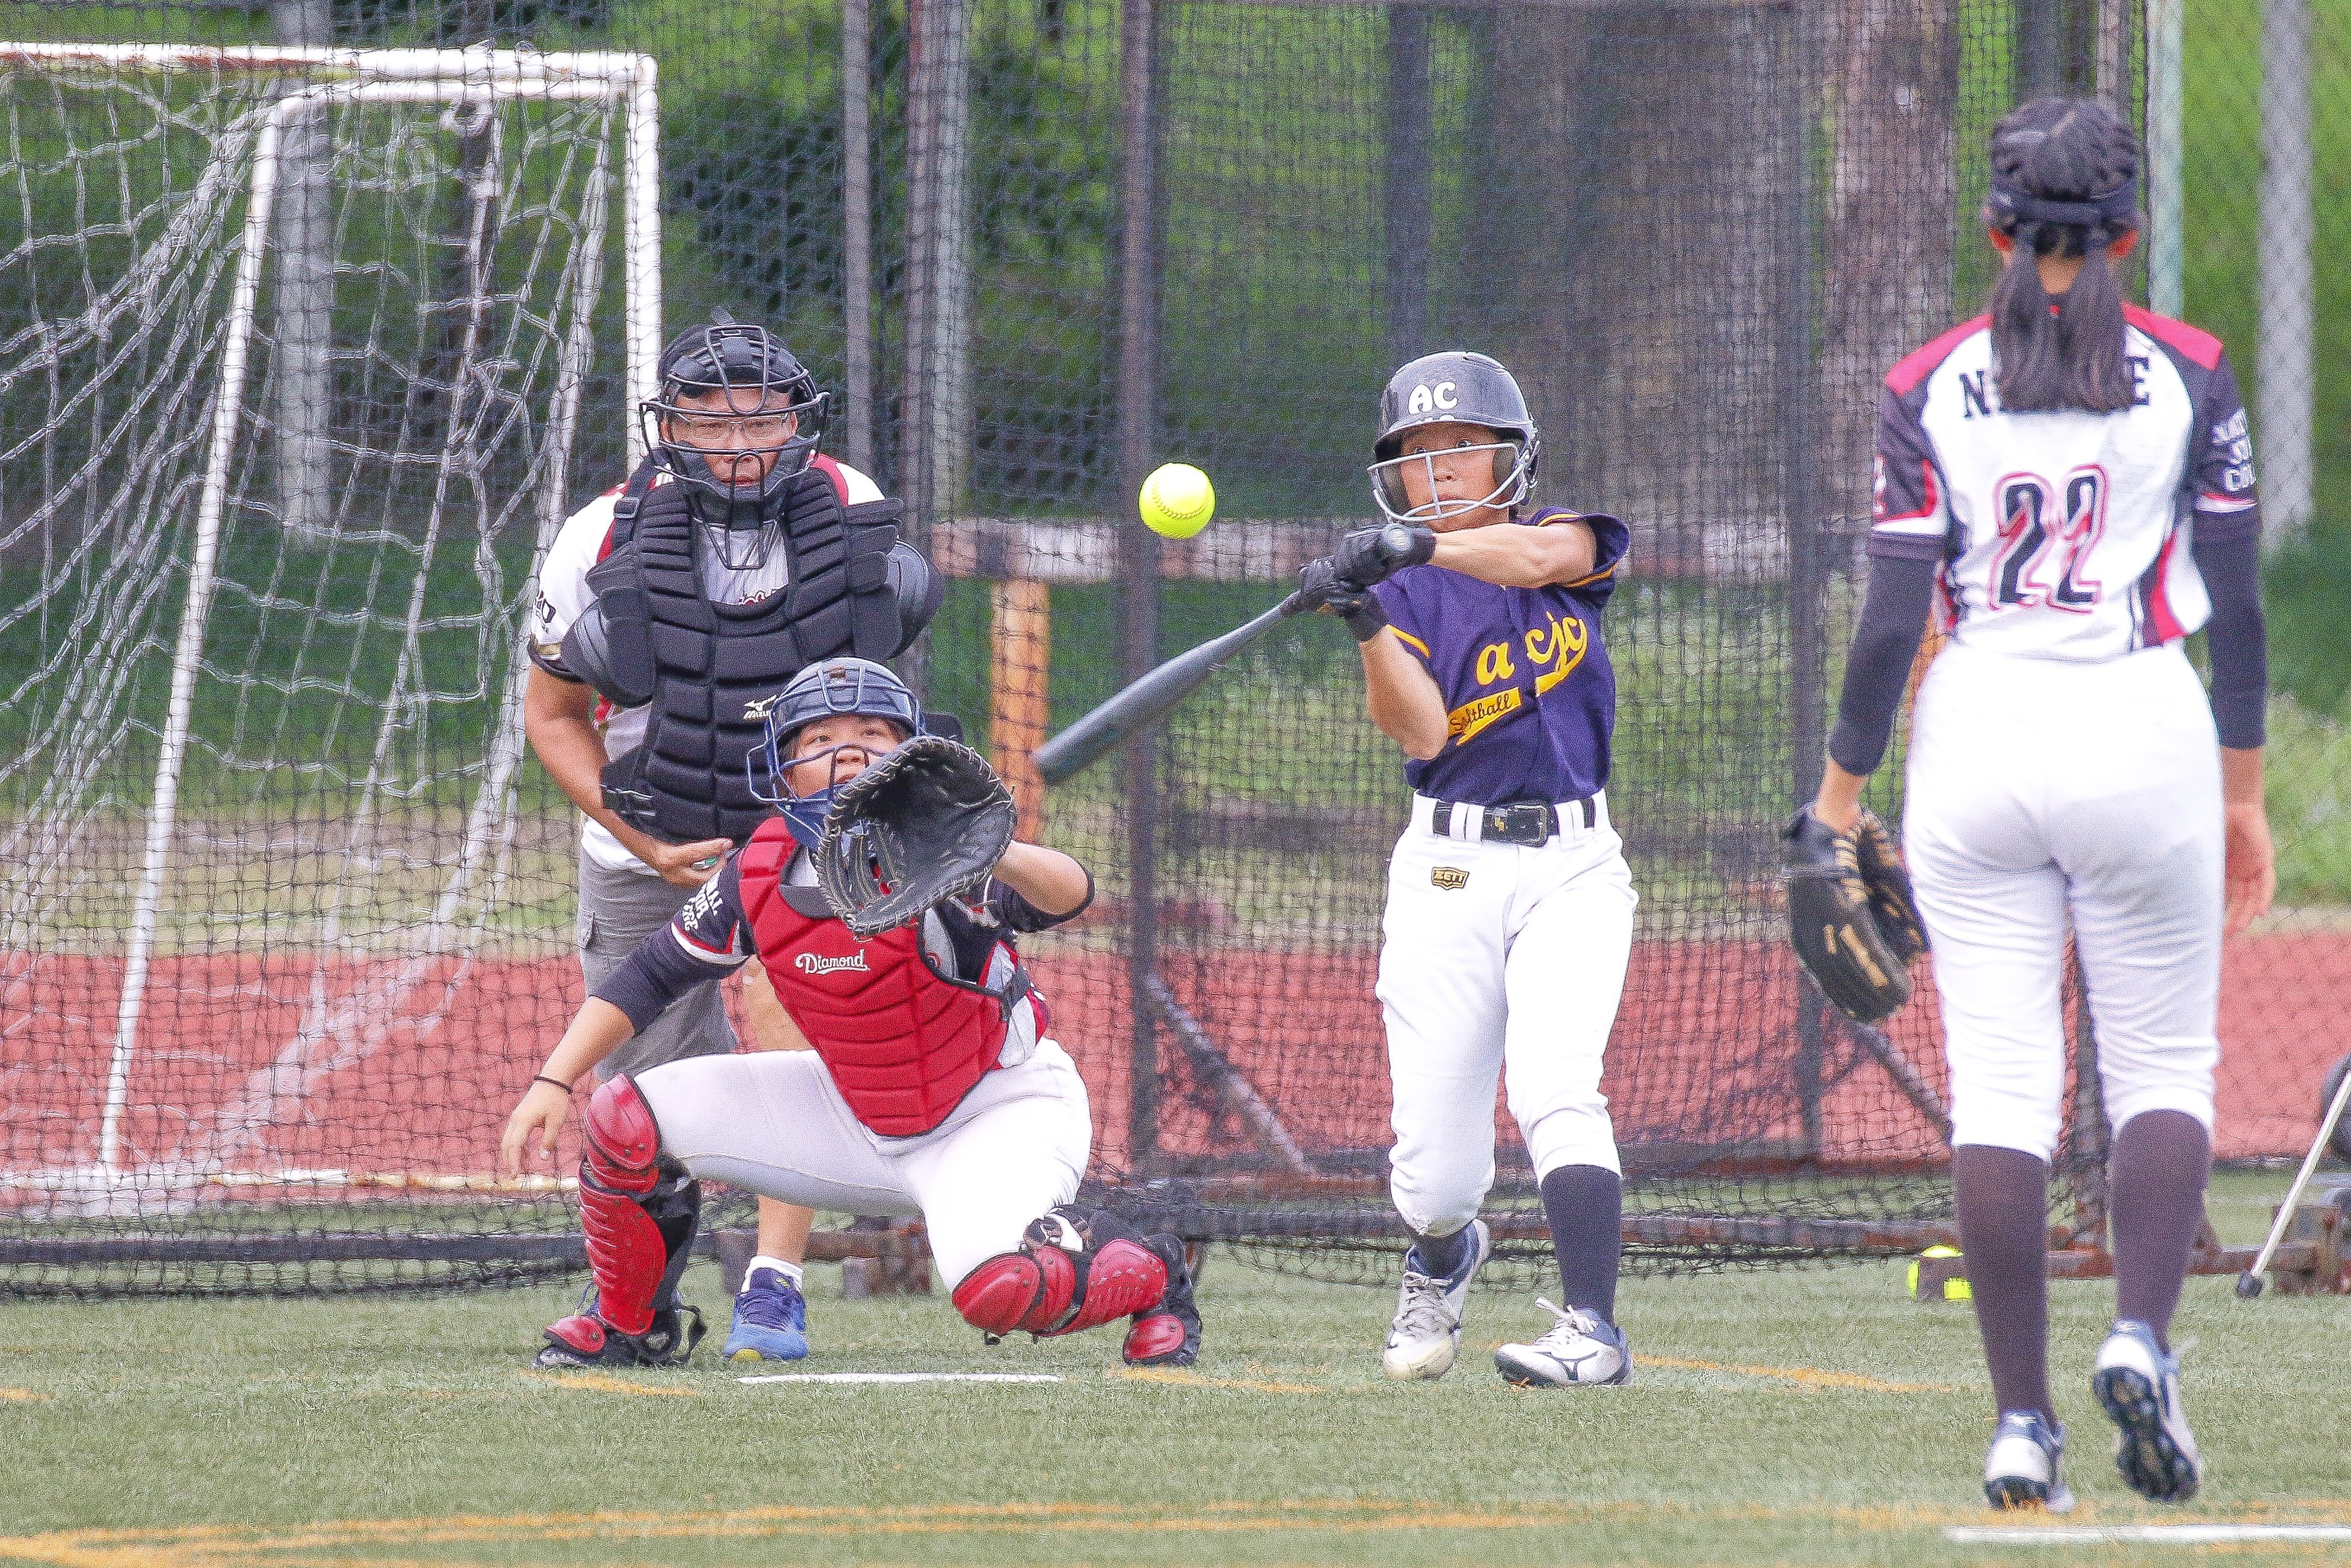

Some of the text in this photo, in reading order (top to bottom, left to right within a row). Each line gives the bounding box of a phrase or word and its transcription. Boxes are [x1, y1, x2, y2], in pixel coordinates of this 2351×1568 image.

[1408, 381, 1459, 416] AC
[1990, 463, 2109, 613] 22
[1433, 870, 1466, 883] ZETT
[794, 948, 870, 975] Diamond
